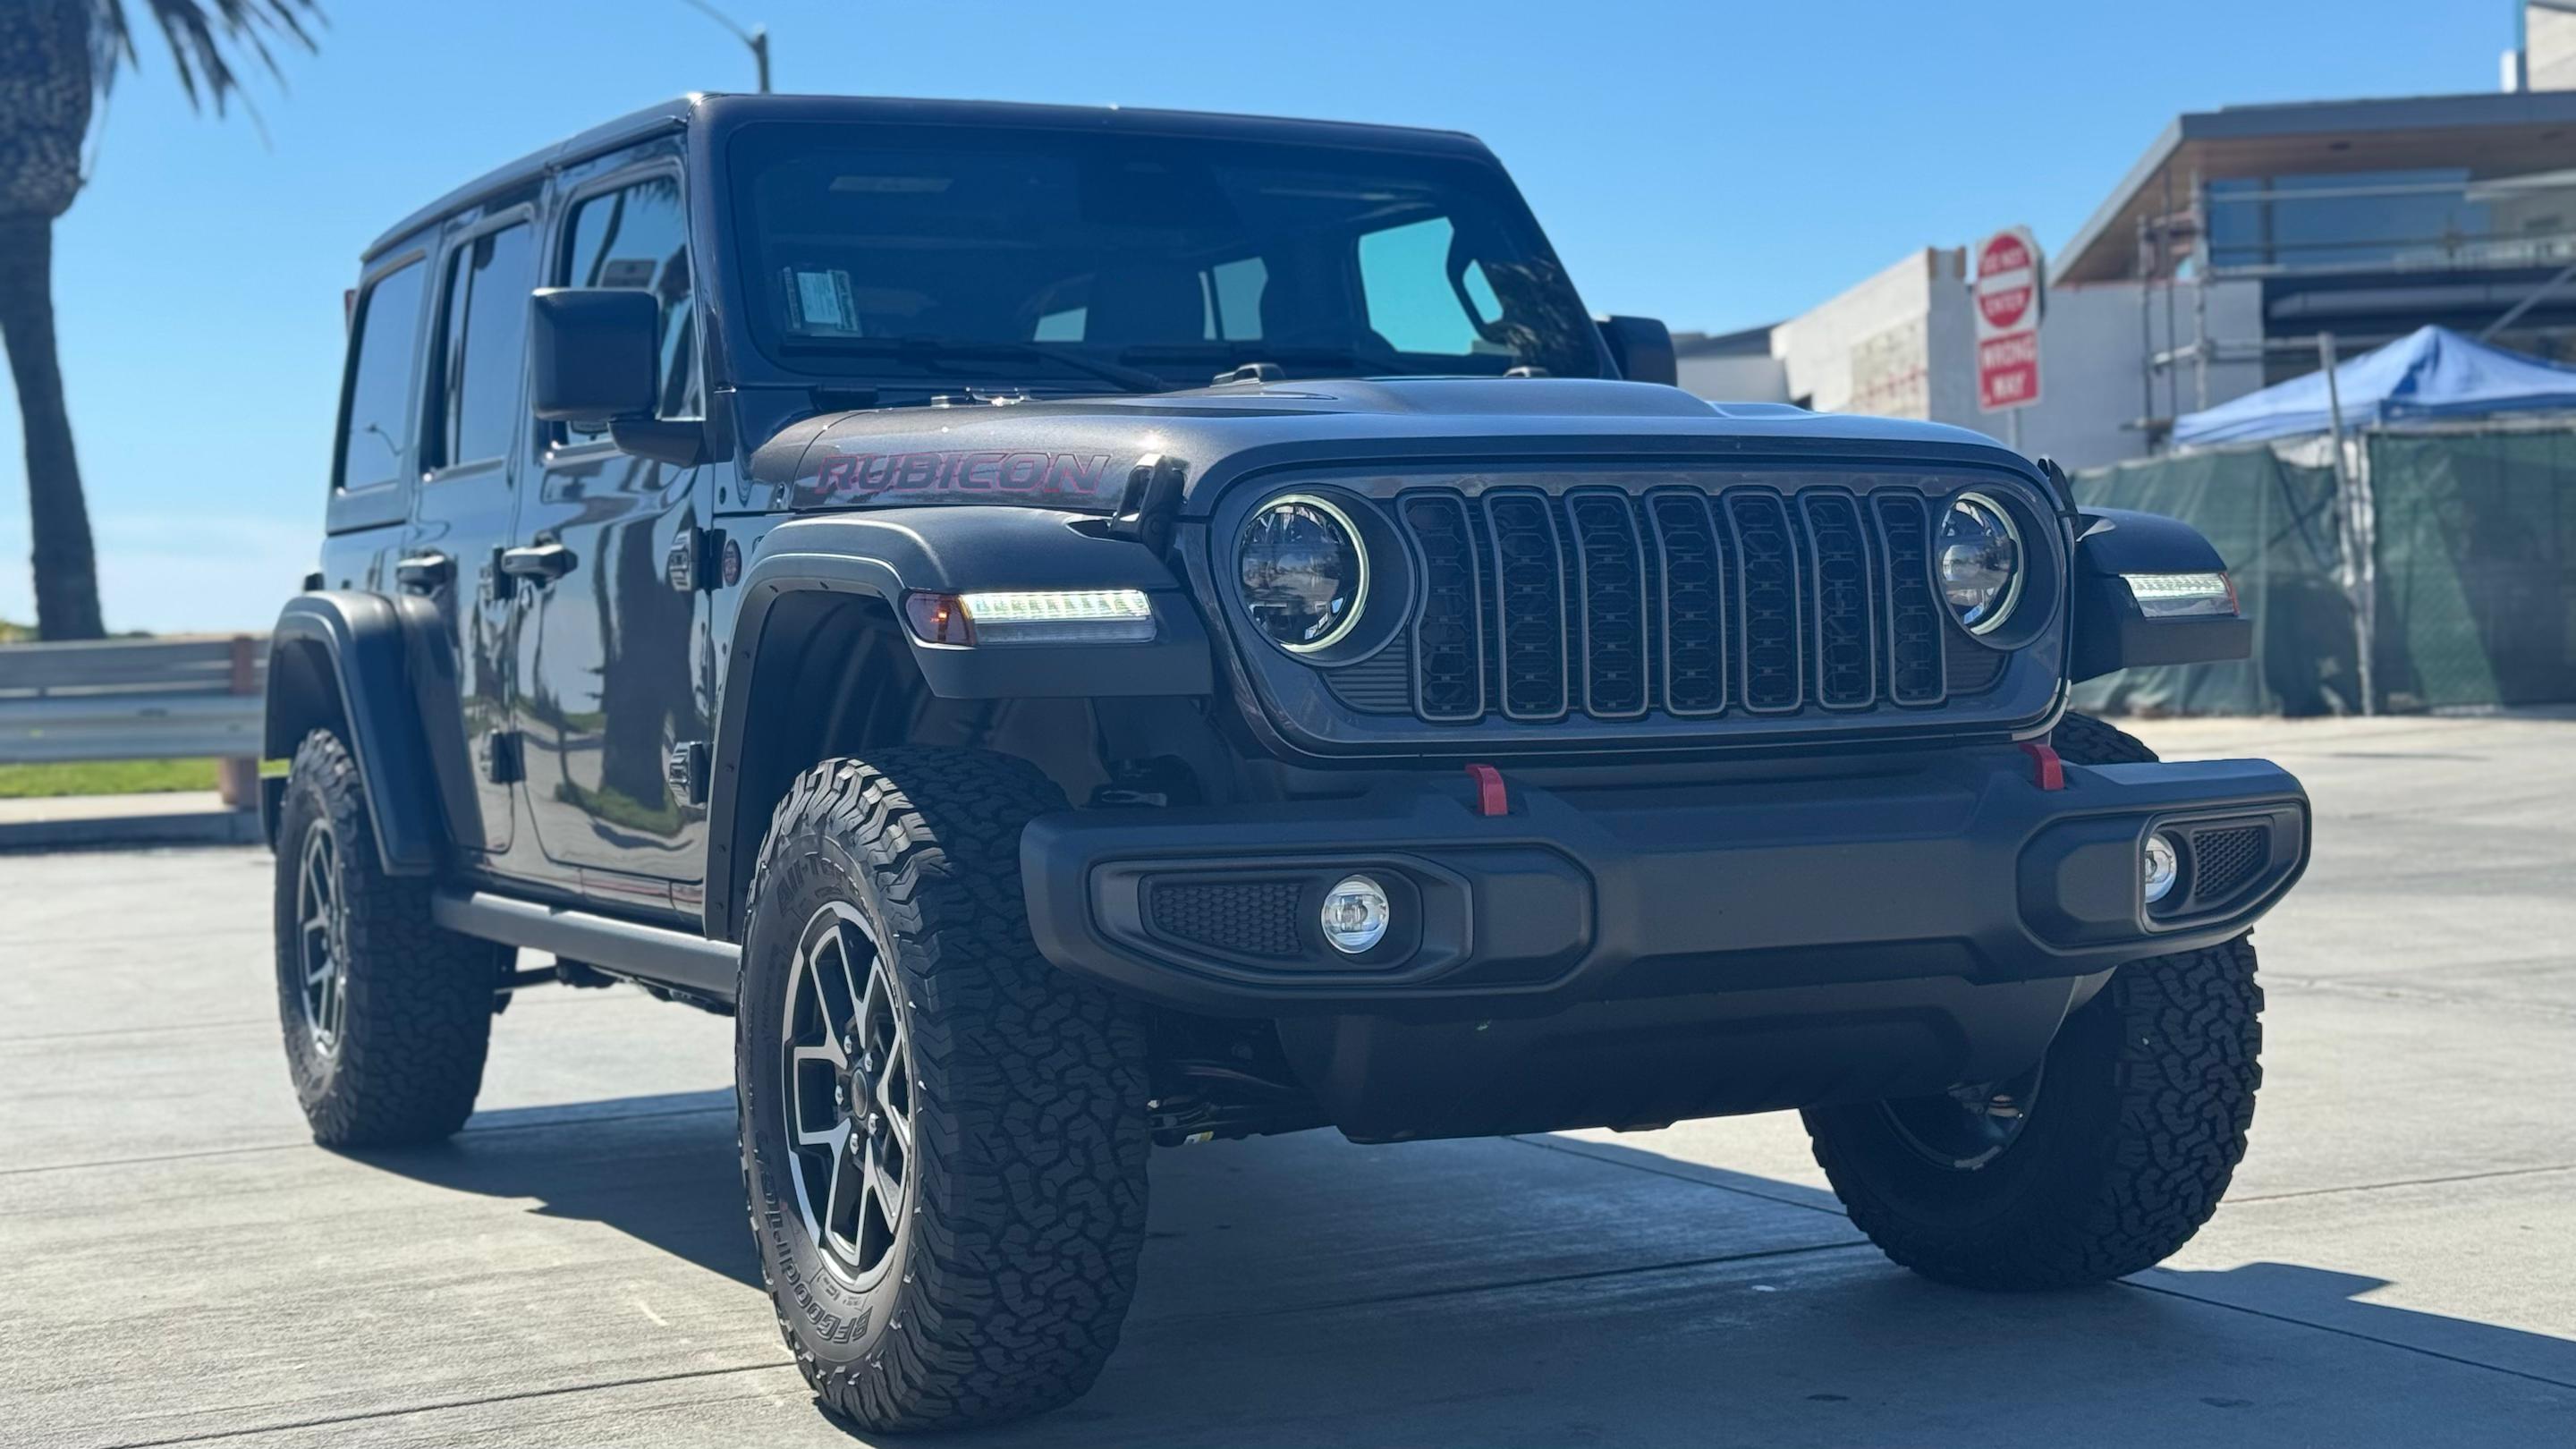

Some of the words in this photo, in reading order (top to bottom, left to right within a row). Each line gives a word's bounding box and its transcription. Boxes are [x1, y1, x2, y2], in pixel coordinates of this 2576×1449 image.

[2001, 246, 2026, 269] NOT
[1984, 292, 2026, 315] ENTER
[1982, 338, 2036, 368] WRONG
[1992, 370, 2026, 399] WAY
[816, 451, 1111, 494] RUBICON
[756, 1130, 873, 1346] BFGoodrich
